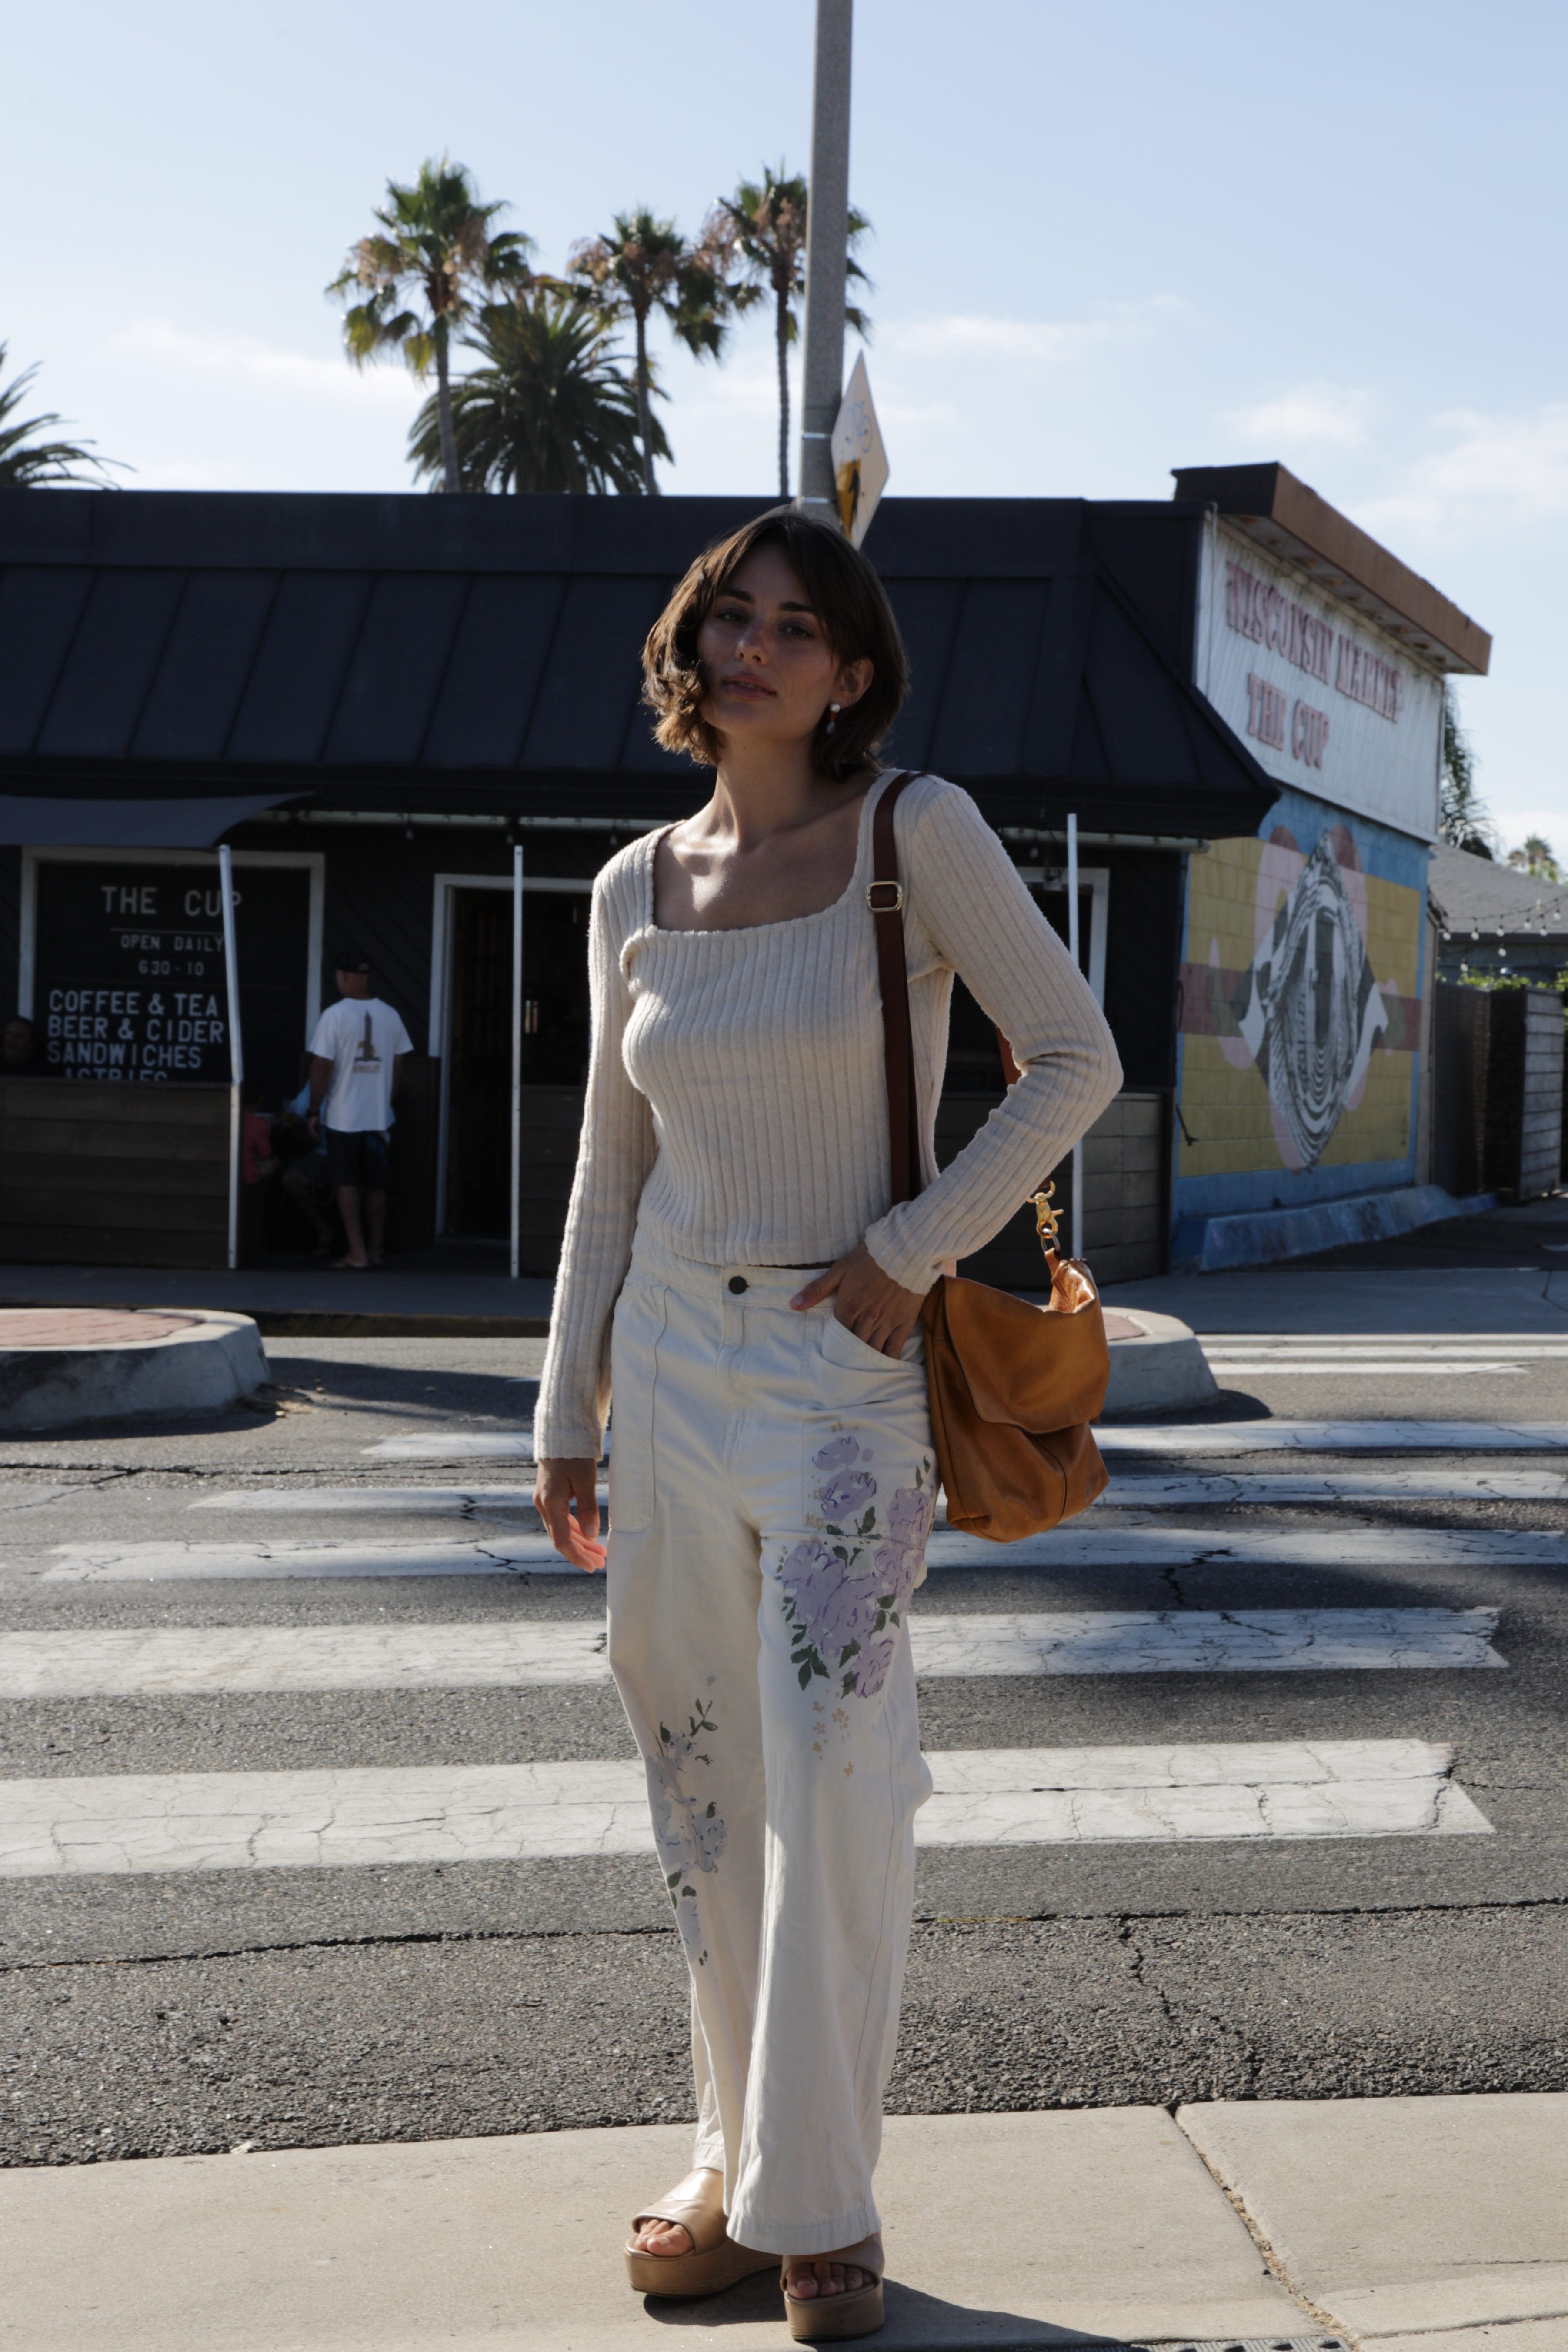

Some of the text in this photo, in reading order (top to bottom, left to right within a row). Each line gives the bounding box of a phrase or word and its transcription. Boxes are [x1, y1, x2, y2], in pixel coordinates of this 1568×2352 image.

[1247, 672, 1329, 769] THE CUP
[101, 885, 157, 914] THE
[120, 934, 224, 952] OPEN DAILY
[49, 989, 218, 1018] COFFEE & TEA
[47, 1014, 224, 1044] BEER & CIDER
[47, 1040, 202, 1069] SANDWICHES
